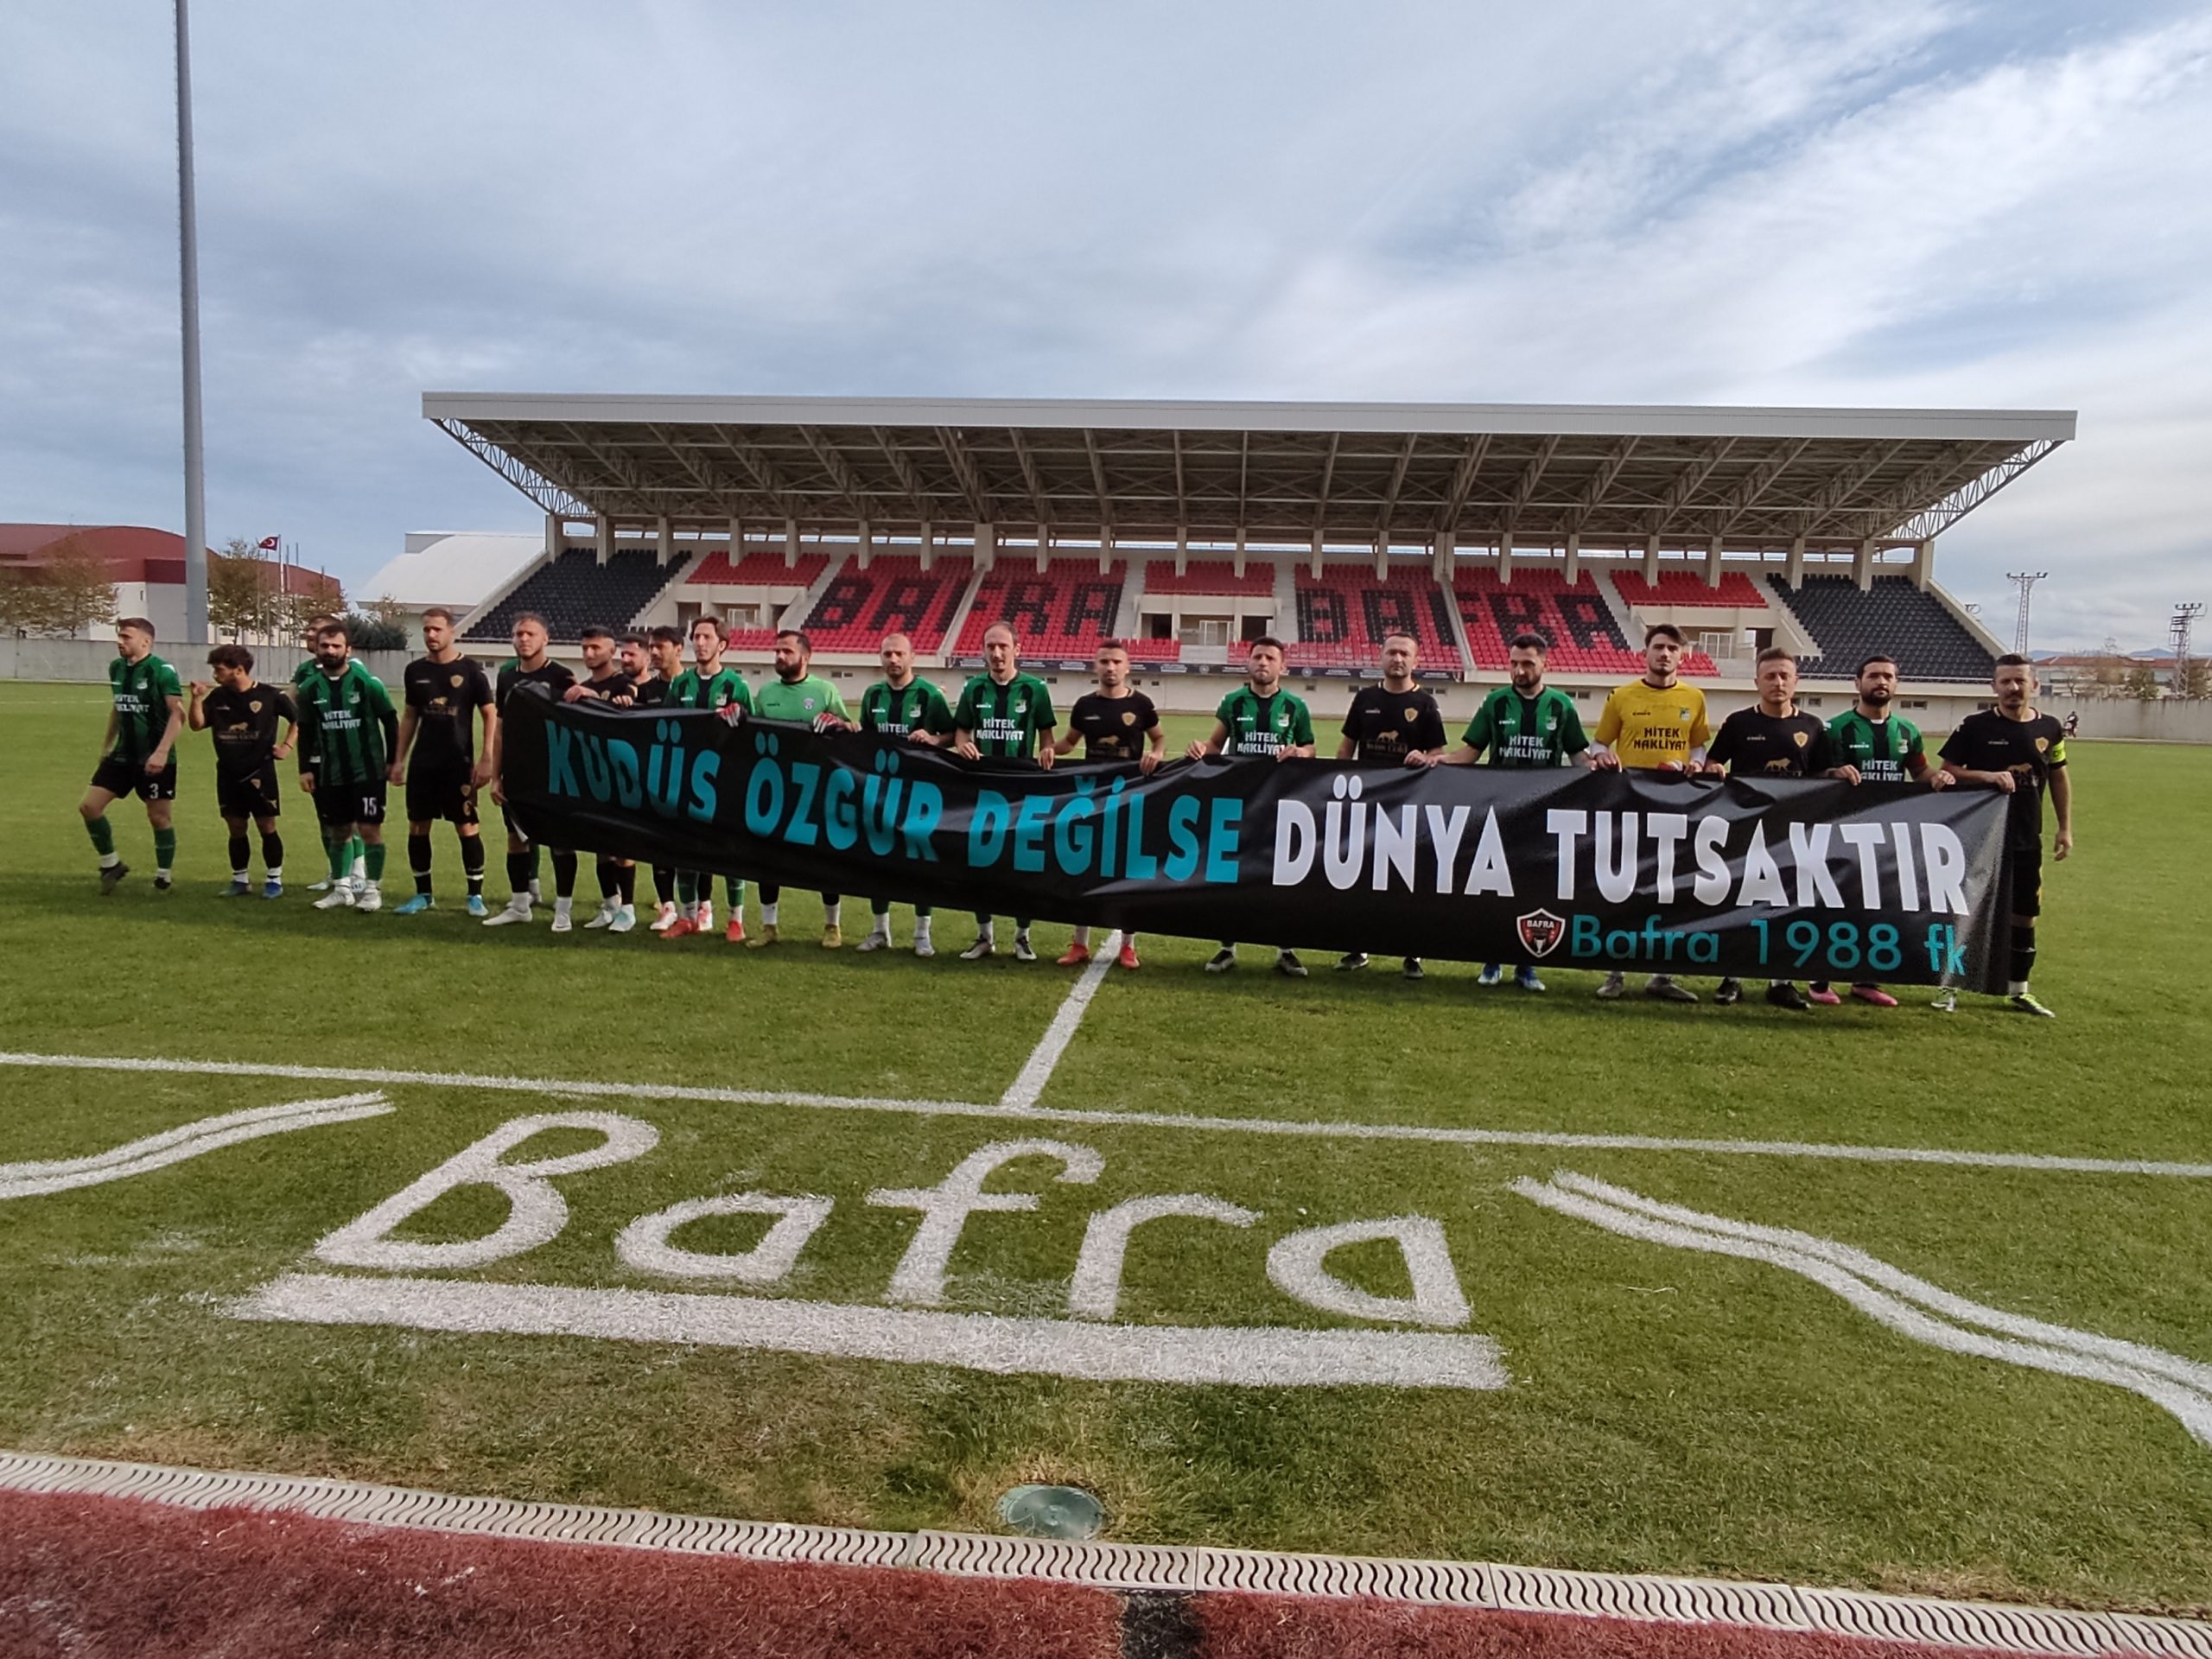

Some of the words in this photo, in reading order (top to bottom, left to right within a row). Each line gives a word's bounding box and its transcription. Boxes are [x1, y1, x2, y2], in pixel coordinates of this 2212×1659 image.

[149, 783, 159, 799] 3
[362, 797, 378, 817] 15
[544, 718, 721, 823] KUDÜS
[745, 732, 944, 861] ÖZGÜR
[968, 775, 1243, 883] DEĞİLSE
[1272, 774, 1515, 897] DÜNYA
[1546, 809, 1970, 916] TUTSAKTIR
[1571, 913, 1720, 963] Bafra
[1750, 918, 1902, 971] 1988
[1924, 923, 1967, 976] fk
[313, 1111, 1472, 1328] Bafra
